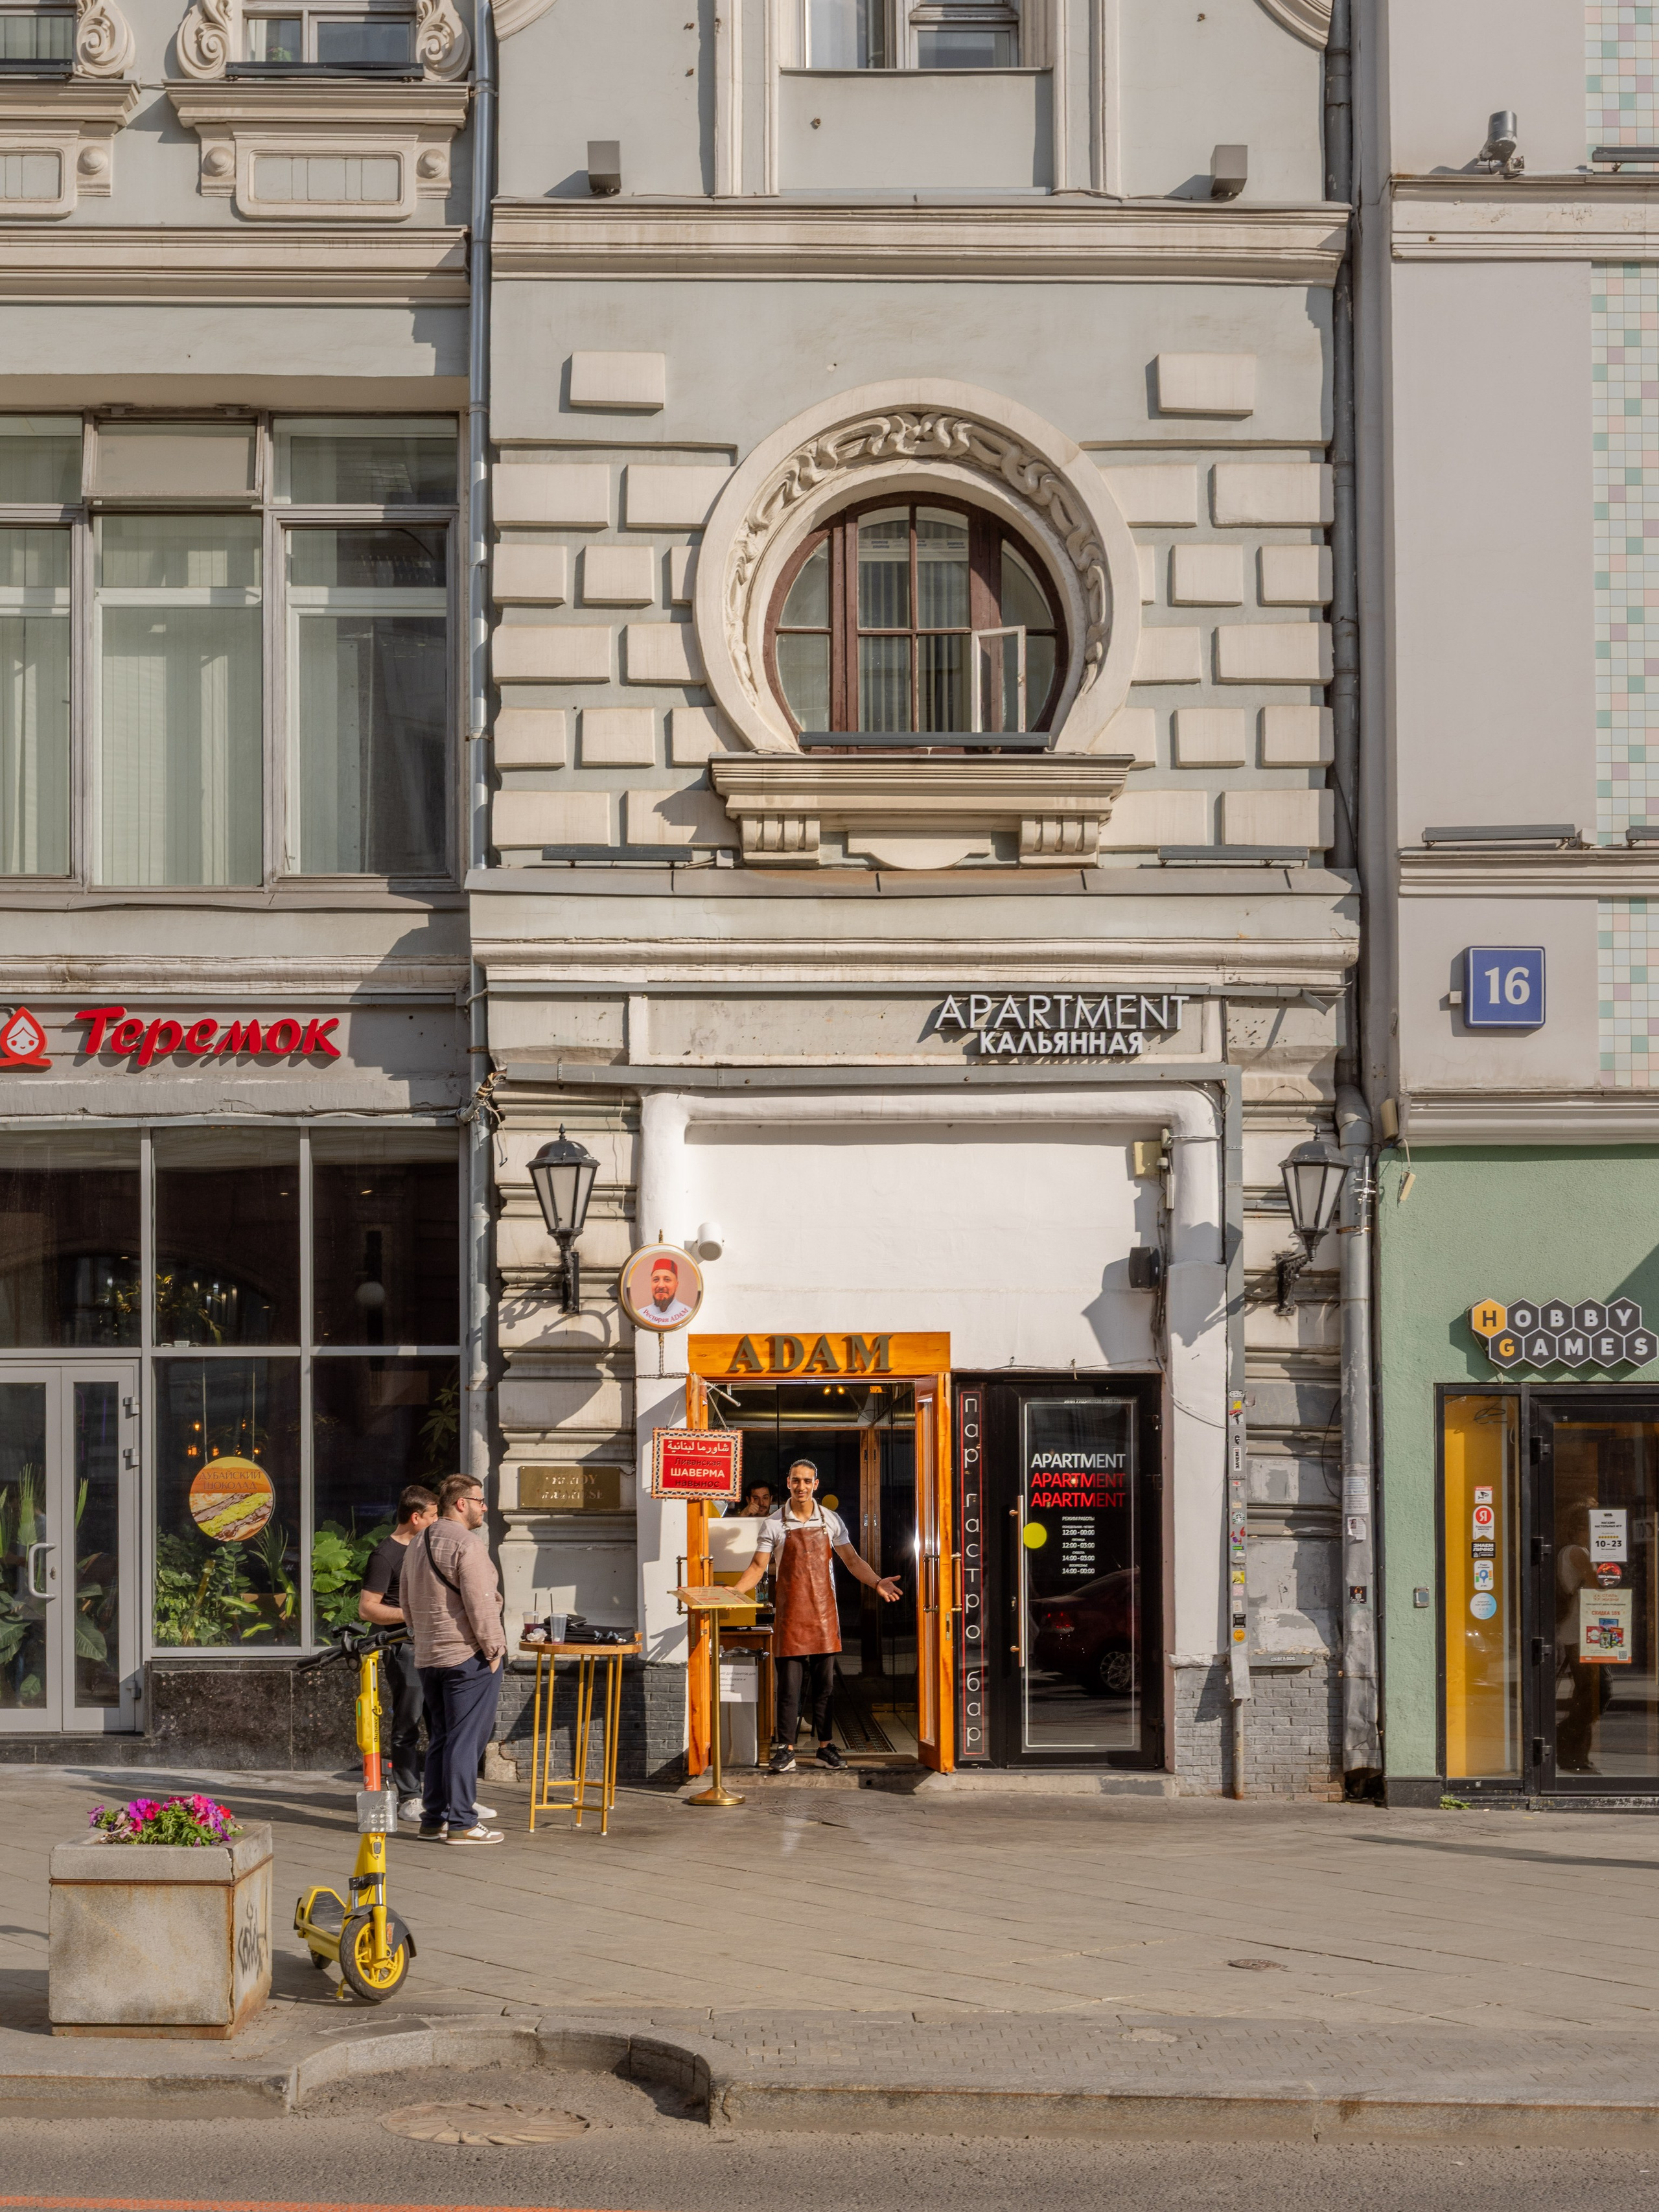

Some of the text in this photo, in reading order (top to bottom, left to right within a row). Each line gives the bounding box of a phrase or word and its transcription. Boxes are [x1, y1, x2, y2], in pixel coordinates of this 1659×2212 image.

[1484, 966, 1530, 1005] 16
[934, 994, 1190, 1030] APARTMENT
[75, 1007, 342, 1067] Теремок
[979, 1031, 1143, 1054] КАЛЬЯННАЯ
[643, 1307, 689, 1323] Ресторан ADAM
[1482, 1309, 1633, 1327] HOBBY
[727, 1334, 894, 1373] ADAM
[1499, 1338, 1648, 1356] GAMES
[667, 1441, 730, 1454] شاورما لبنانية
[674, 1458, 721, 1466] Ливанская
[1031, 1454, 1126, 1469] APARTMENT
[199, 1470, 261, 1480] ДУБАЙСКИЙ
[670, 1467, 725, 1478] ШАВЕРМА
[203, 1482, 257, 1491] ШОКОЛАД
[675, 1480, 720, 1488] навынос
[1031, 1473, 1126, 1488] APARTMENT
[1031, 1492, 1126, 1507] APARTMENT
